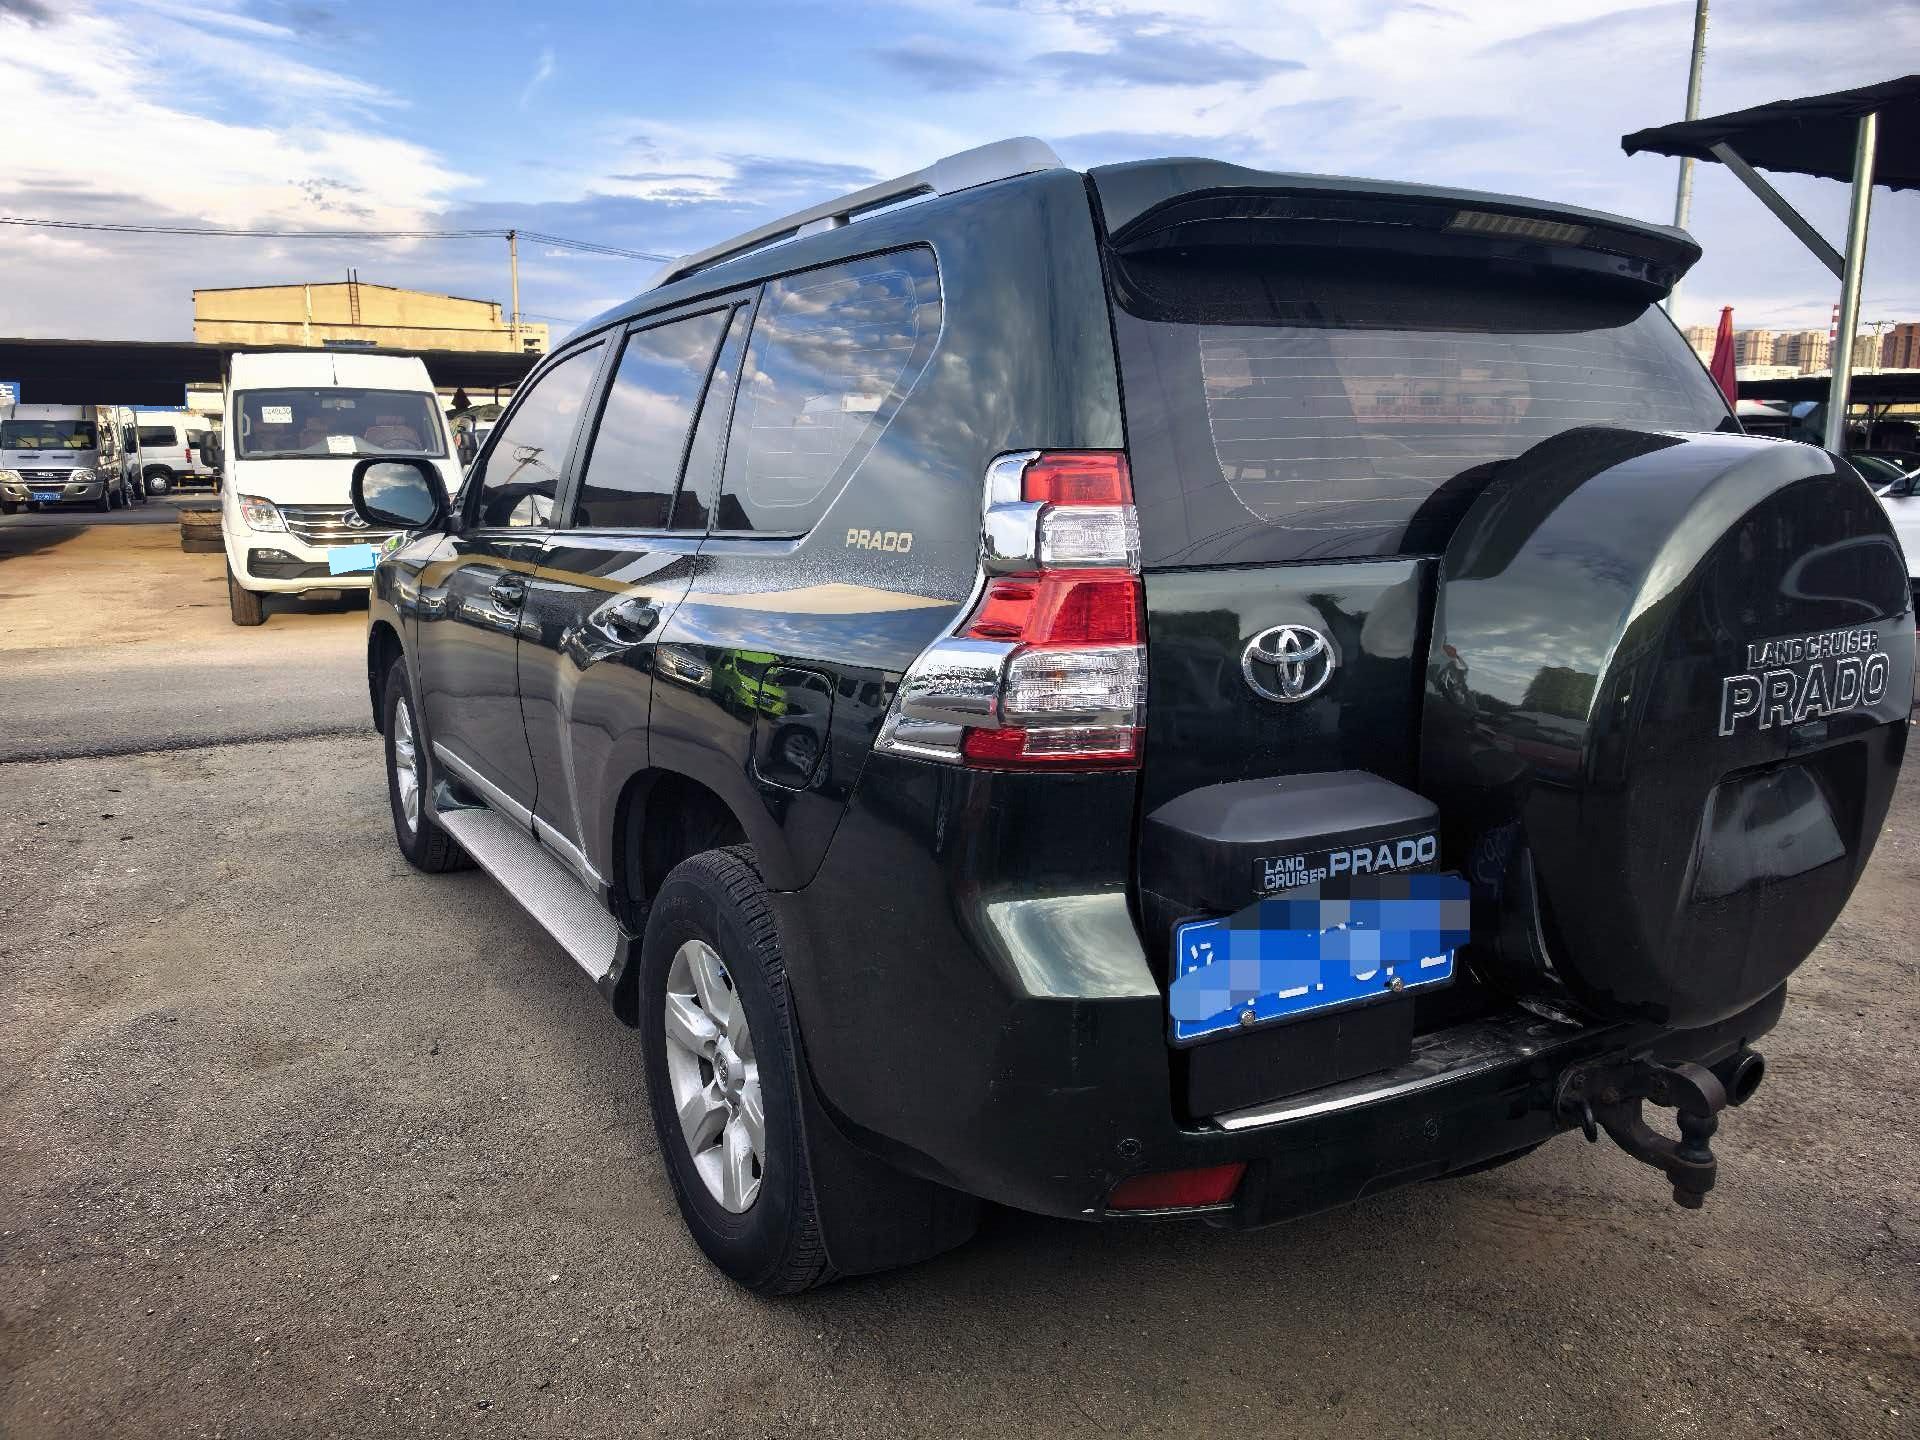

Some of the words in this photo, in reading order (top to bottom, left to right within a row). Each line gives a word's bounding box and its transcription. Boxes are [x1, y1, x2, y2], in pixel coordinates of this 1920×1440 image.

[846, 528, 912, 553] PRADO
[1747, 638, 1805, 670] LAND
[1805, 630, 1879, 661] CRUISER
[1718, 652, 1890, 737] PRADO
[1264, 856, 1306, 875] LAND
[1329, 835, 1438, 878] PRADO
[1264, 867, 1327, 890] CRUISER
